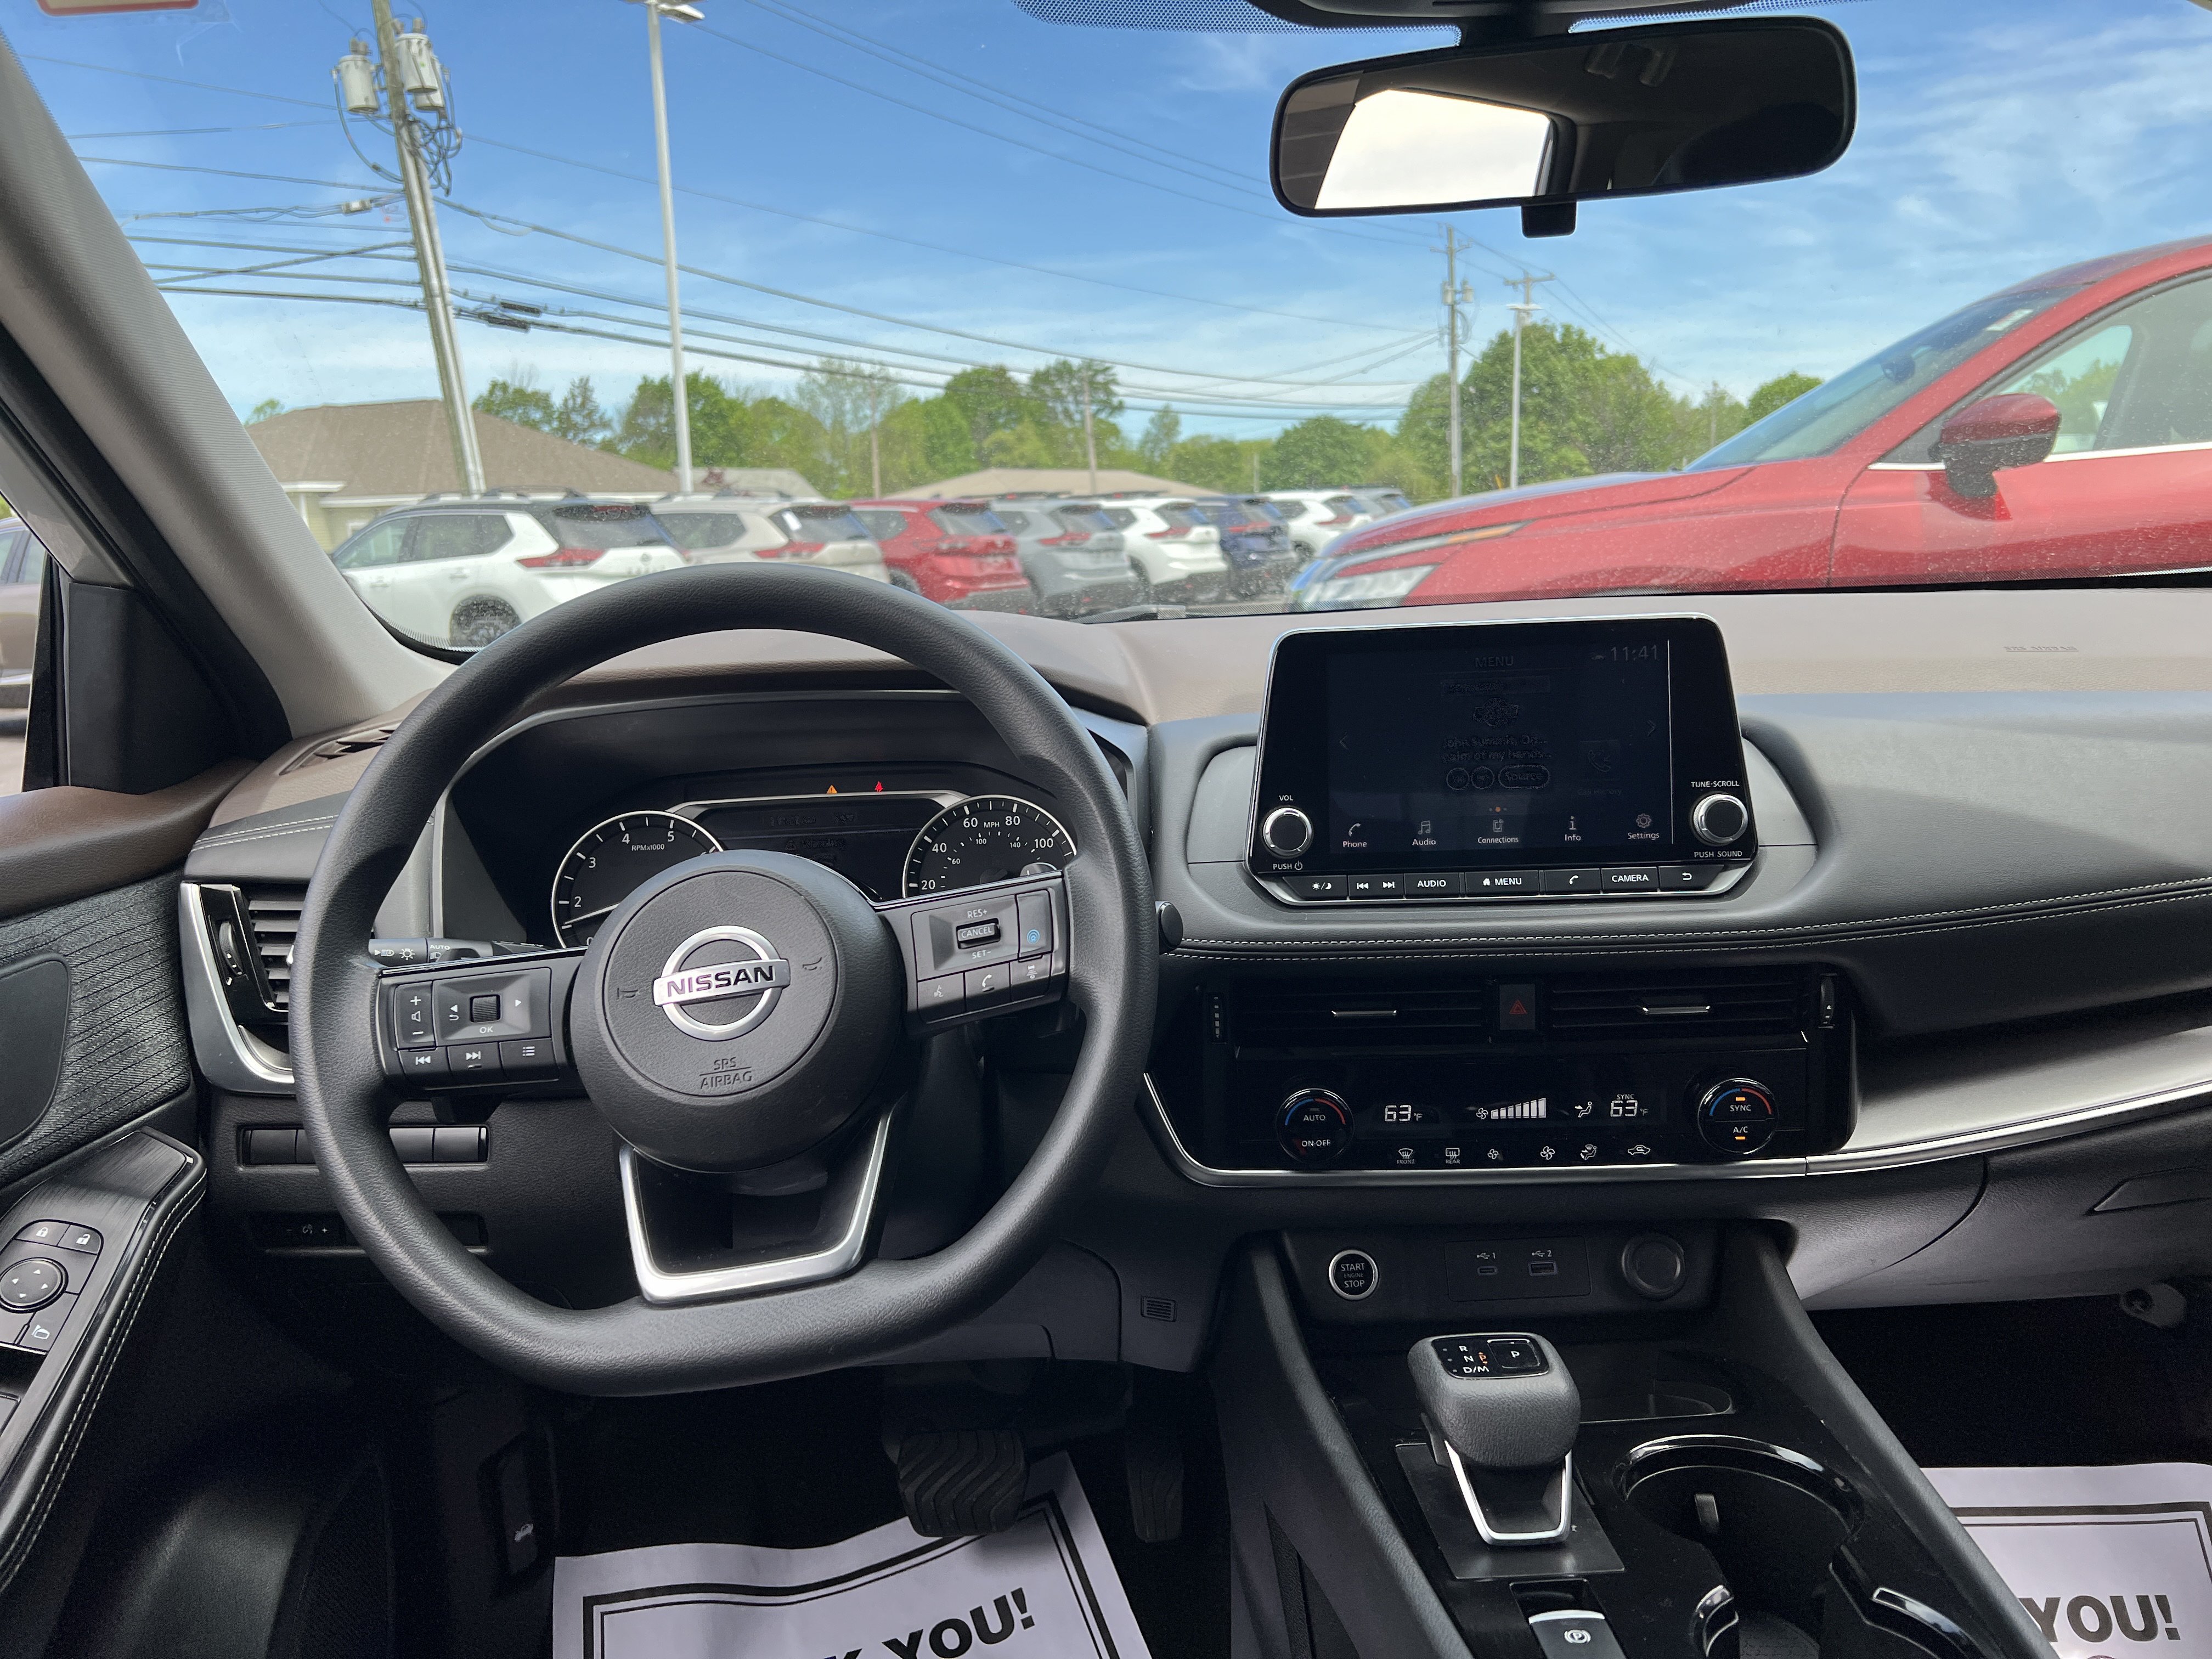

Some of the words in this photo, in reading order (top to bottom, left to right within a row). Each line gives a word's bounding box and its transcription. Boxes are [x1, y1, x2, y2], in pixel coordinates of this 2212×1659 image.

[1611, 645, 1658, 662] 11:41
[1475, 656, 1514, 668] MENU
[963, 817, 978, 828] 60
[1005, 815, 1020, 826] 80
[622, 833, 630, 844] 4
[667, 831, 675, 842] 5
[1477, 835, 1519, 844] Connections
[1565, 833, 1582, 842] Info
[1627, 832, 1660, 840] Settings
[631, 843, 665, 851] RPMx1000
[932, 842, 947, 853] 40
[1034, 837, 1054, 849] 100
[1342, 840, 1367, 848] Phone
[1412, 838, 1436, 846] Audio
[589, 857, 596, 868] 3
[1417, 879, 1447, 888] AUDIO
[1494, 877, 1522, 886] MENU
[1611, 874, 1649, 883] CAMERA
[921, 879, 936, 890] 20
[574, 895, 582, 908] 2
[967, 909, 988, 919] RES+
[961, 926, 992, 939] CANCEL
[667, 966, 774, 997] NISSAN
[479, 1025, 494, 1034] OK
[713, 1057, 736, 1071] SRS
[700, 1071, 752, 1089] AIRBAG
[1730, 1104, 1751, 1112] SYNC
[1340, 1262, 1365, 1272] START
[1344, 1279, 1365, 1288] STOP
[1510, 1350, 1520, 1358] P
[1463, 1365, 1489, 1374] D/M
[882, 1587, 1035, 1659] YOU!
[2017, 1595, 2181, 1643] YOU!
